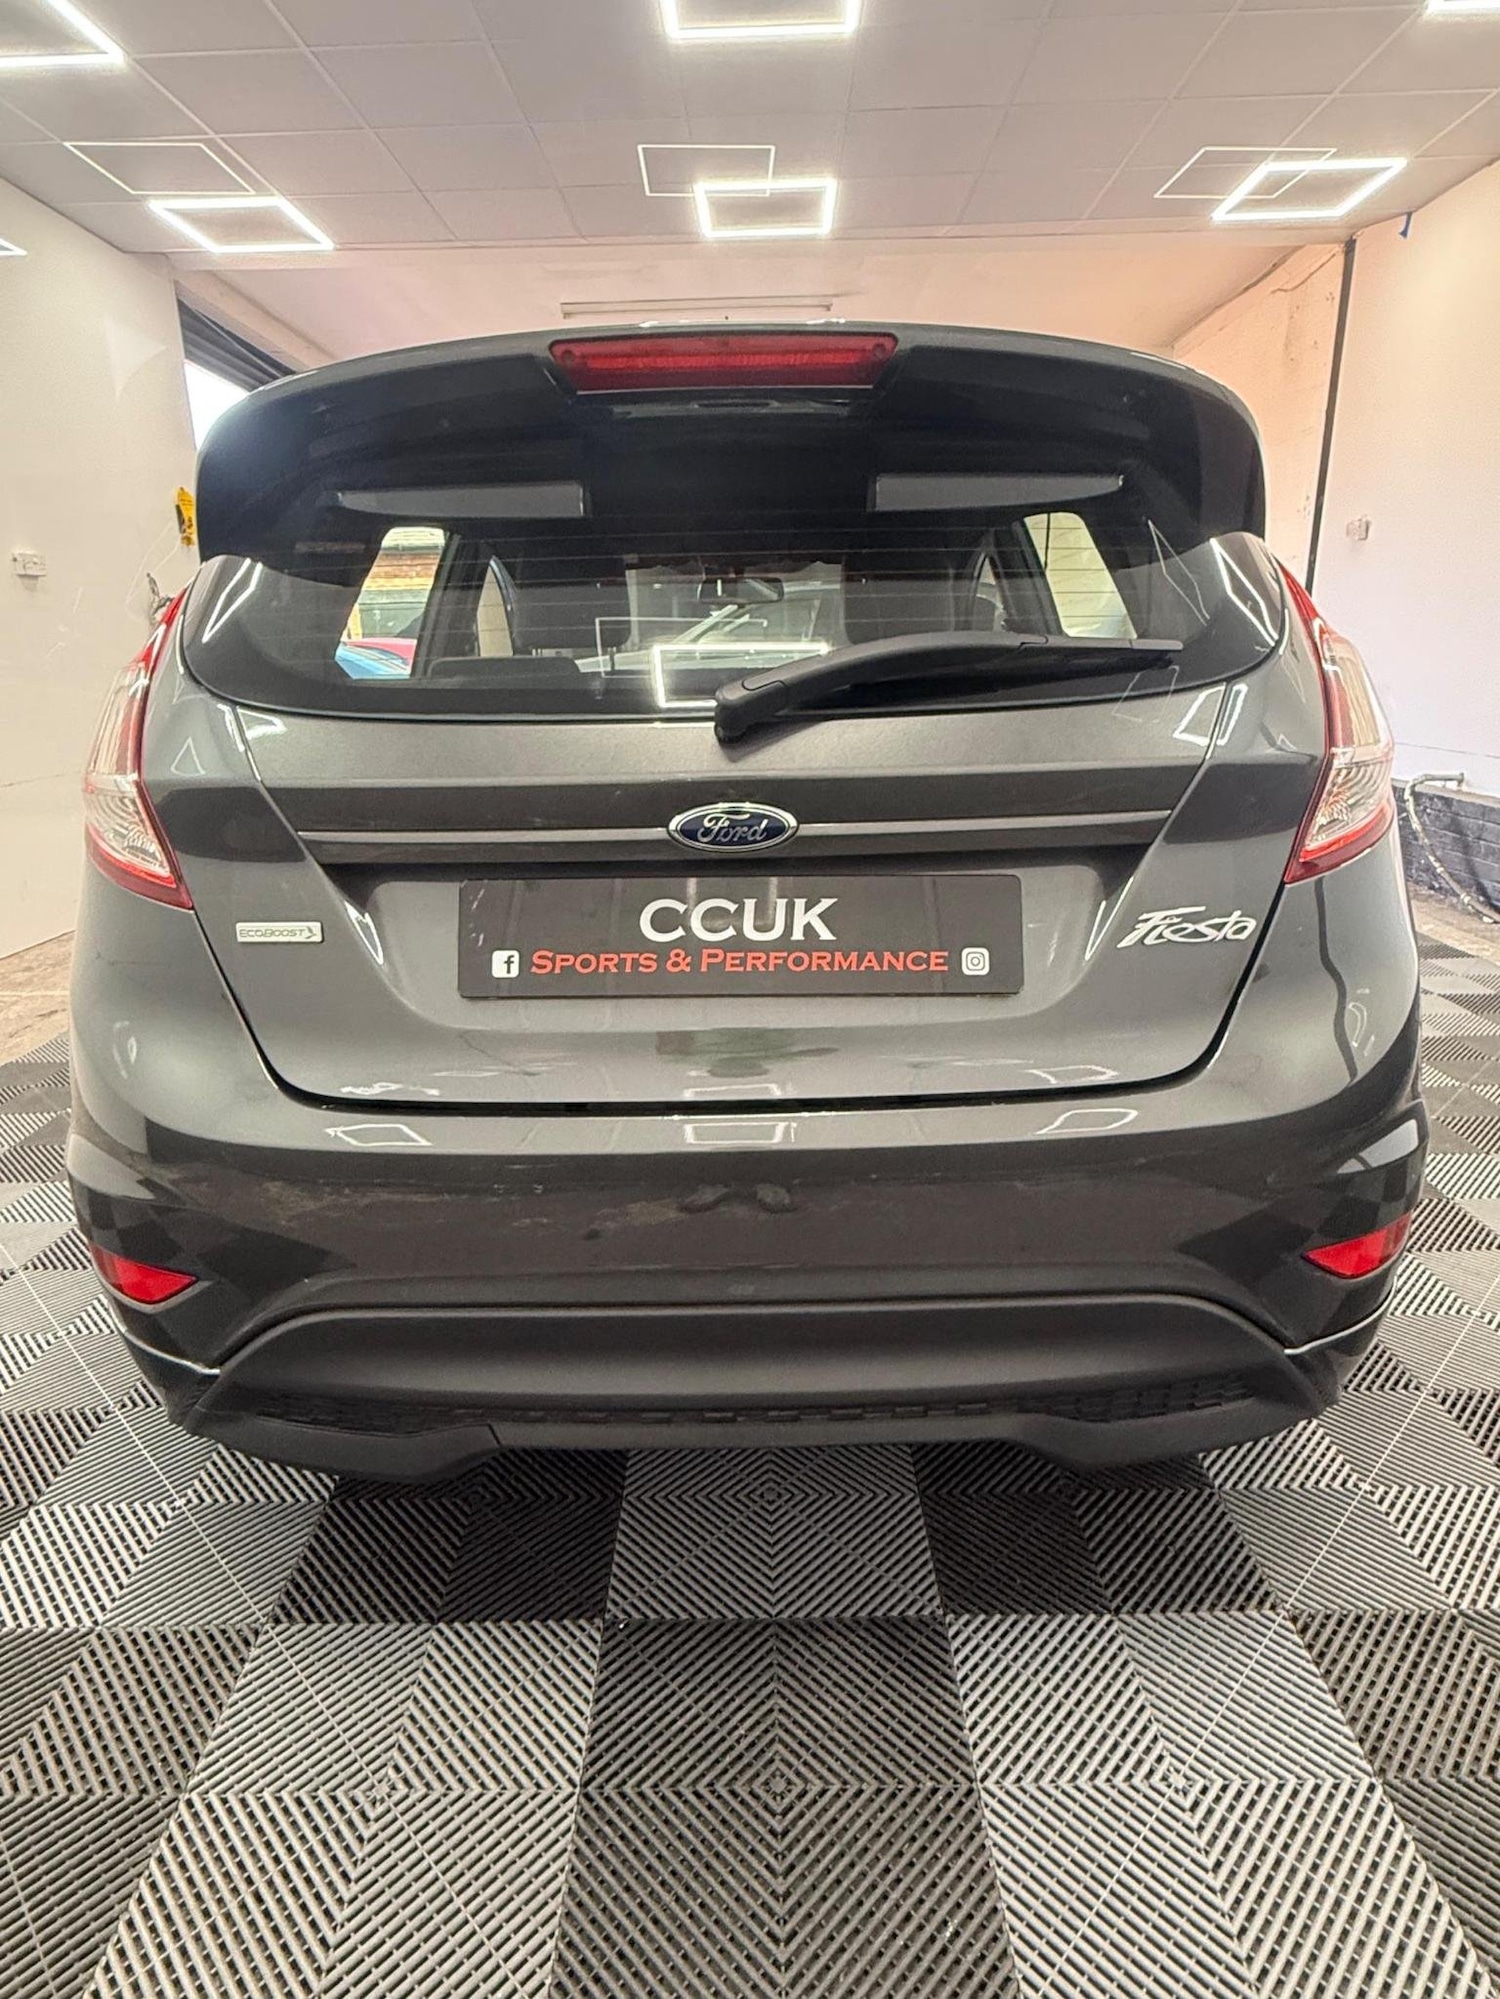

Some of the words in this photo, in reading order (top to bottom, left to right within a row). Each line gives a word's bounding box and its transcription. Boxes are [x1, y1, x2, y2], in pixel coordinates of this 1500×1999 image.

[697, 812, 769, 843] Ford
[639, 898, 838, 942] CCUK
[1116, 905, 1257, 948] Fiesta
[530, 949, 656, 974] SPORTS
[666, 948, 691, 972] &
[700, 949, 948, 972] PERFORMANCE
